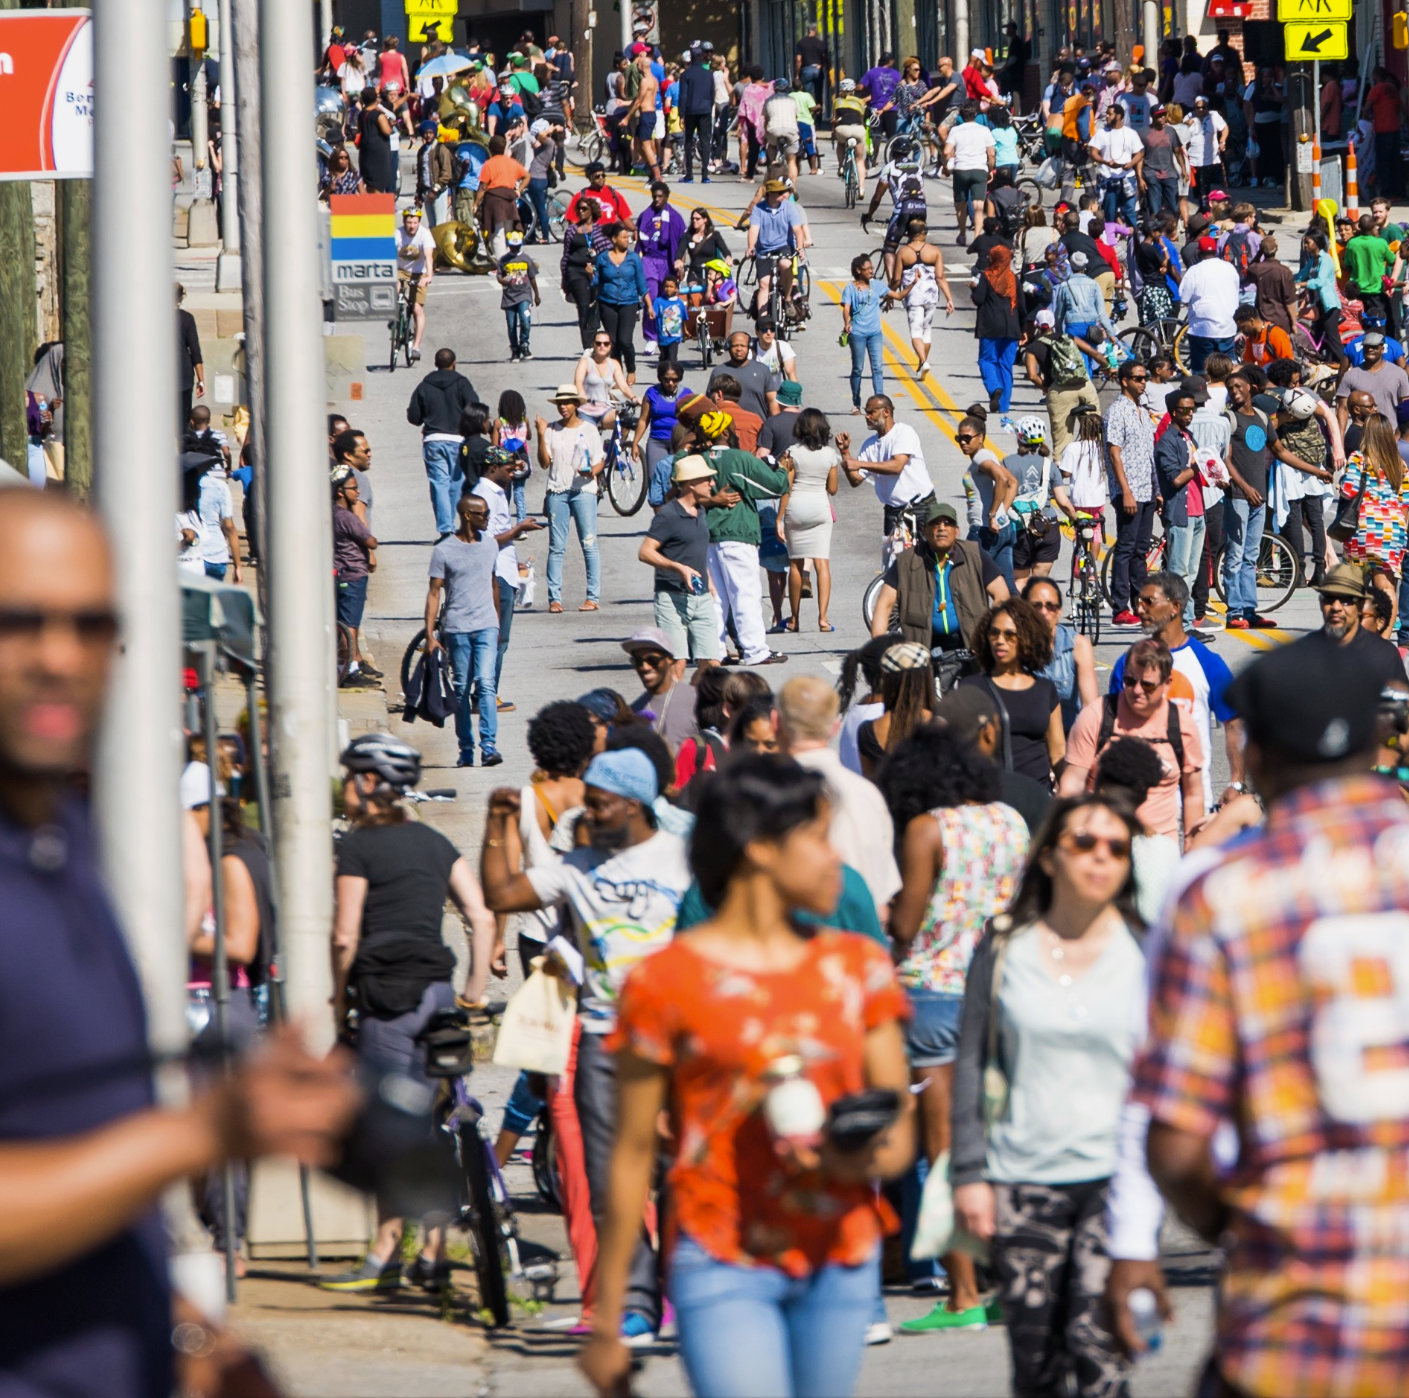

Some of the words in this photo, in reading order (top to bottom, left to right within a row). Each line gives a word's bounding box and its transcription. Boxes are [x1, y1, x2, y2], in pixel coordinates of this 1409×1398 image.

[337, 263, 394, 278] marta
[338, 284, 365, 298] Bus
[338, 298, 369, 315] Stop
